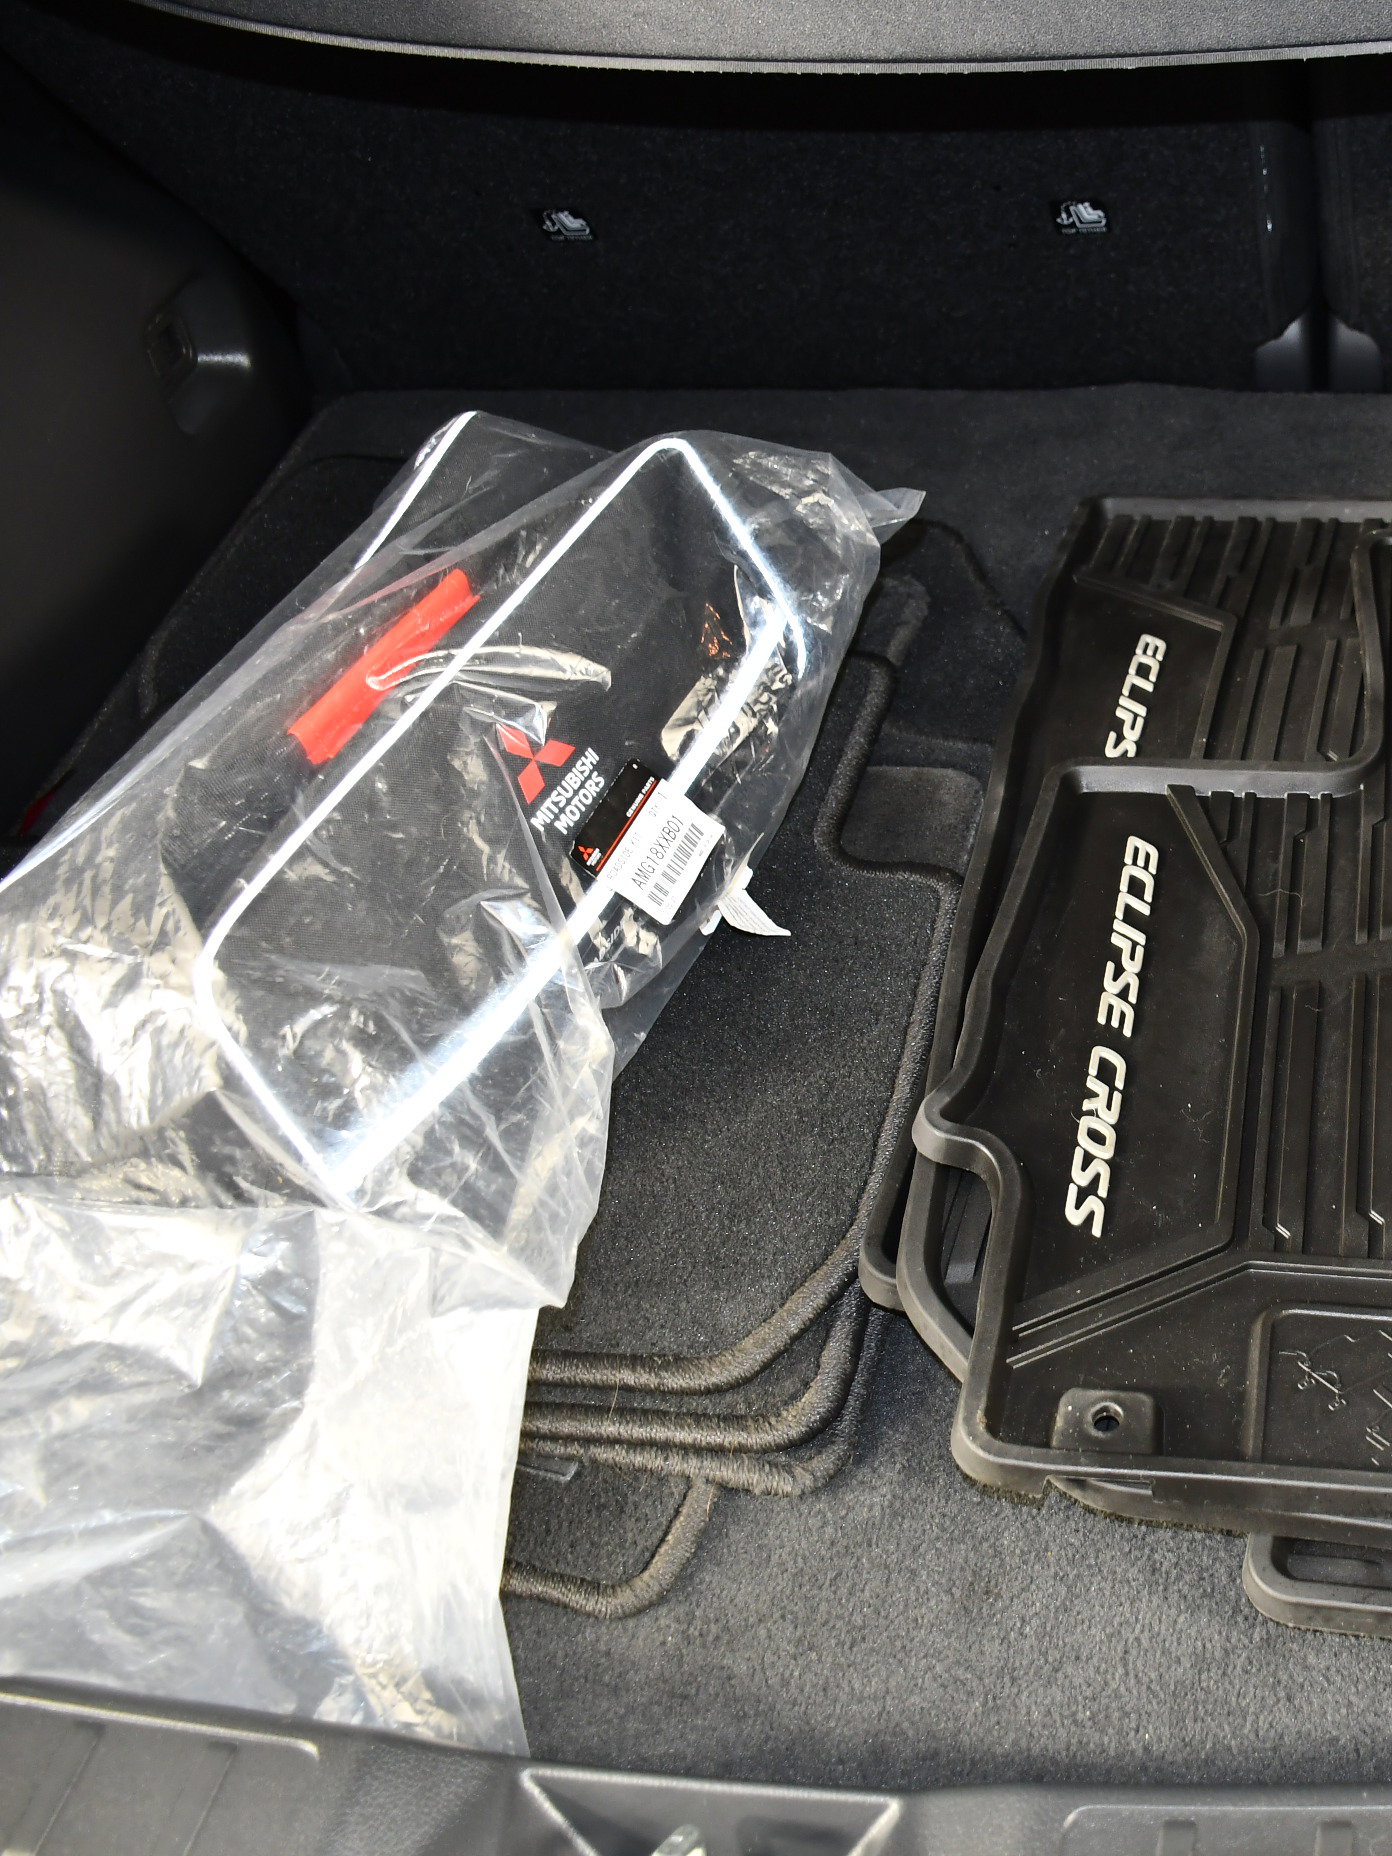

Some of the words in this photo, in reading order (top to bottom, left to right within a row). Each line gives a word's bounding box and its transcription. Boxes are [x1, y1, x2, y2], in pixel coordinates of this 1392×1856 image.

[1105, 633, 1167, 758] ECLIPS
[530, 747, 600, 832] MITSUBISHI
[554, 770, 605, 835] MOTORS
[631, 815, 684, 890] AMG18XXB01
[1097, 835, 1159, 1037] ECLIPSE
[1065, 1046, 1127, 1238] CROSS
